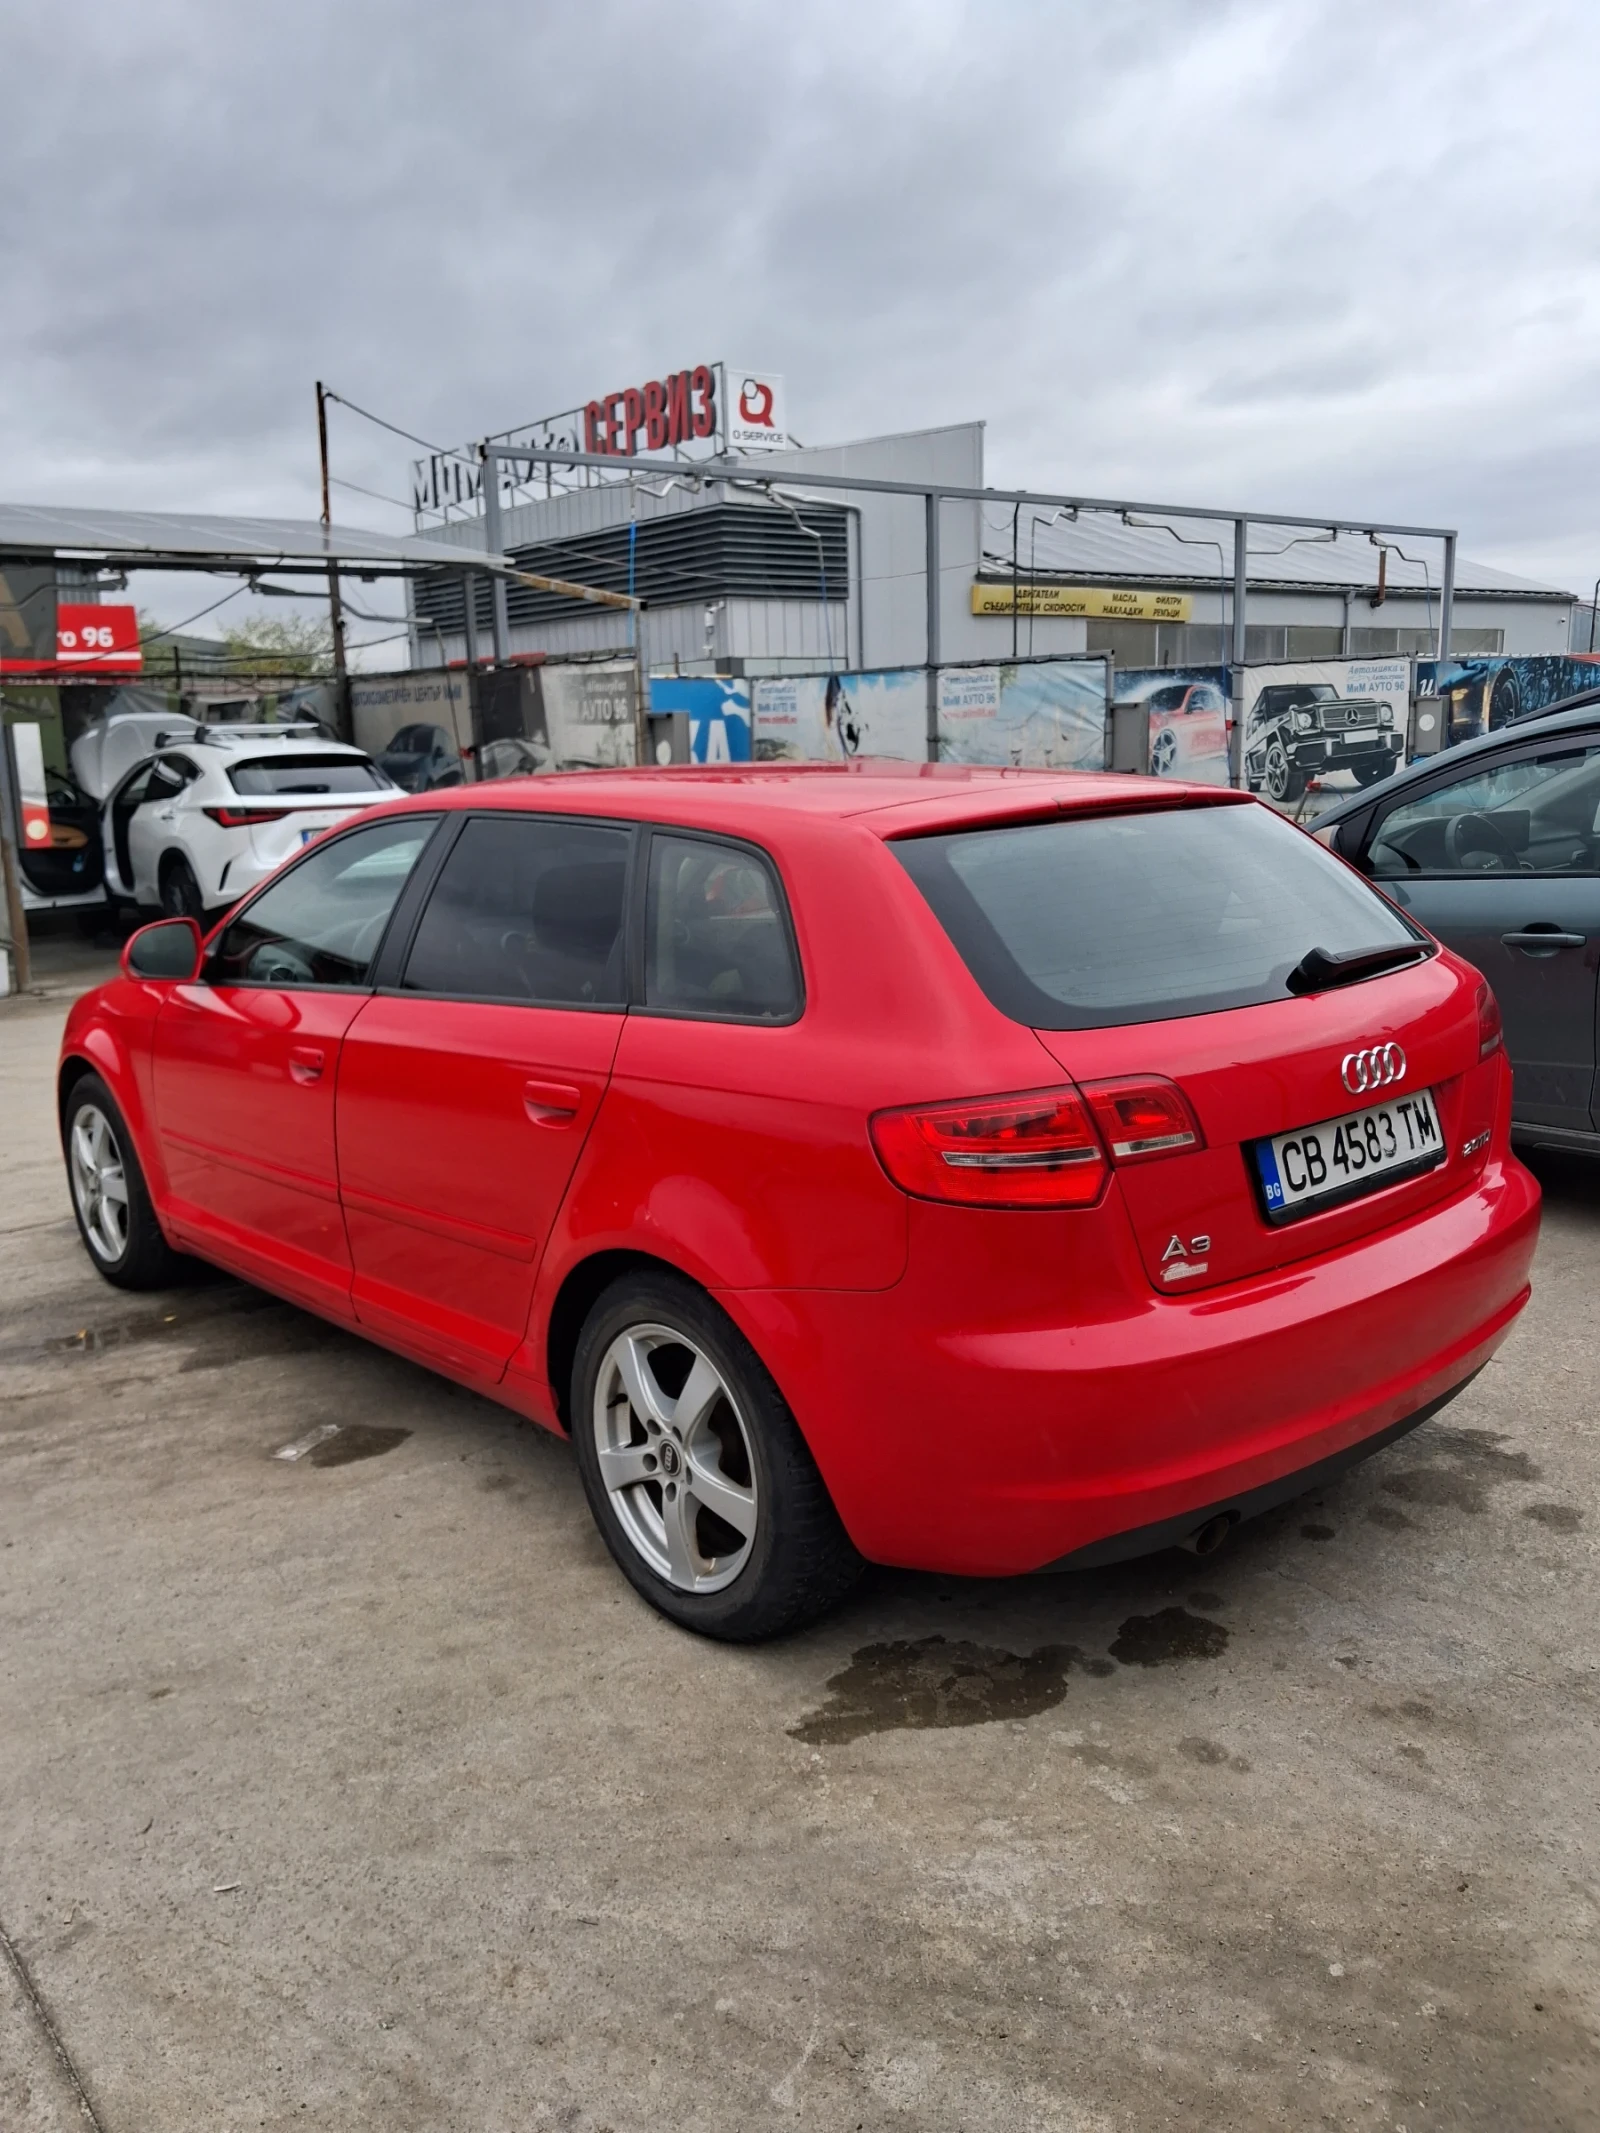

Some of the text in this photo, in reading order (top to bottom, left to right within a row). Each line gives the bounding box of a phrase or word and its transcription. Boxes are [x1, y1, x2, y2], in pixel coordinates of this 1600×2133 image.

[584, 364, 717, 456] СЕРВИЗ
[1016, 589, 1060, 599] ДВИГАТЕЛИ
[1112, 593, 1138, 603] МАСЛА
[1155, 596, 1183, 606] ФИЛТРИ
[1043, 603, 1086, 612] СКОРОСТИ
[1102, 605, 1144, 616] НАКЛАДКИ
[81, 626, 114, 648] 96
[1368, 681, 1392, 692] АУТО
[1394, 681, 1405, 691] 96
[581, 698, 612, 720] АУТО
[1282, 1097, 1437, 1192] CB 4583 TM
[1266, 1183, 1281, 1200] BG
[1161, 1235, 1211, 1261] A3
